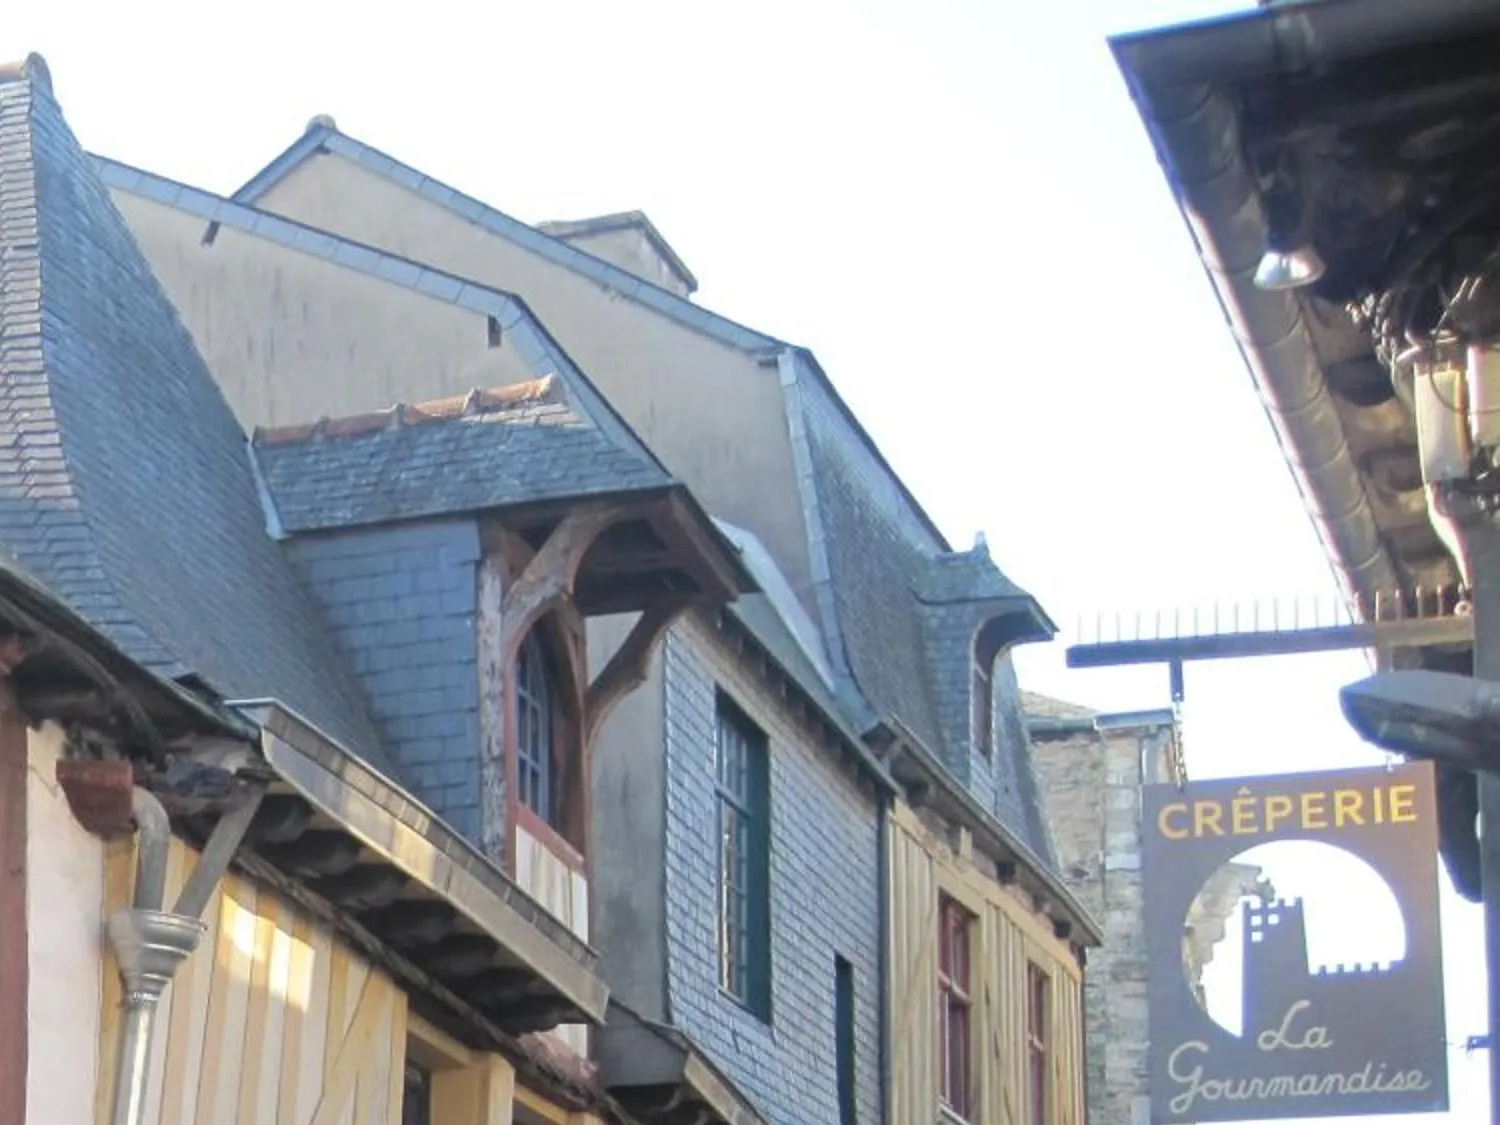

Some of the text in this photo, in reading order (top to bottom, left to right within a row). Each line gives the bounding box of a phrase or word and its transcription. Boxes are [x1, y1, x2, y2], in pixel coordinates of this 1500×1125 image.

[1158, 785, 1418, 840] CRÊPERIE
[1257, 1000, 1333, 1051] La
[1168, 1041, 1431, 1114] Gourmandise
